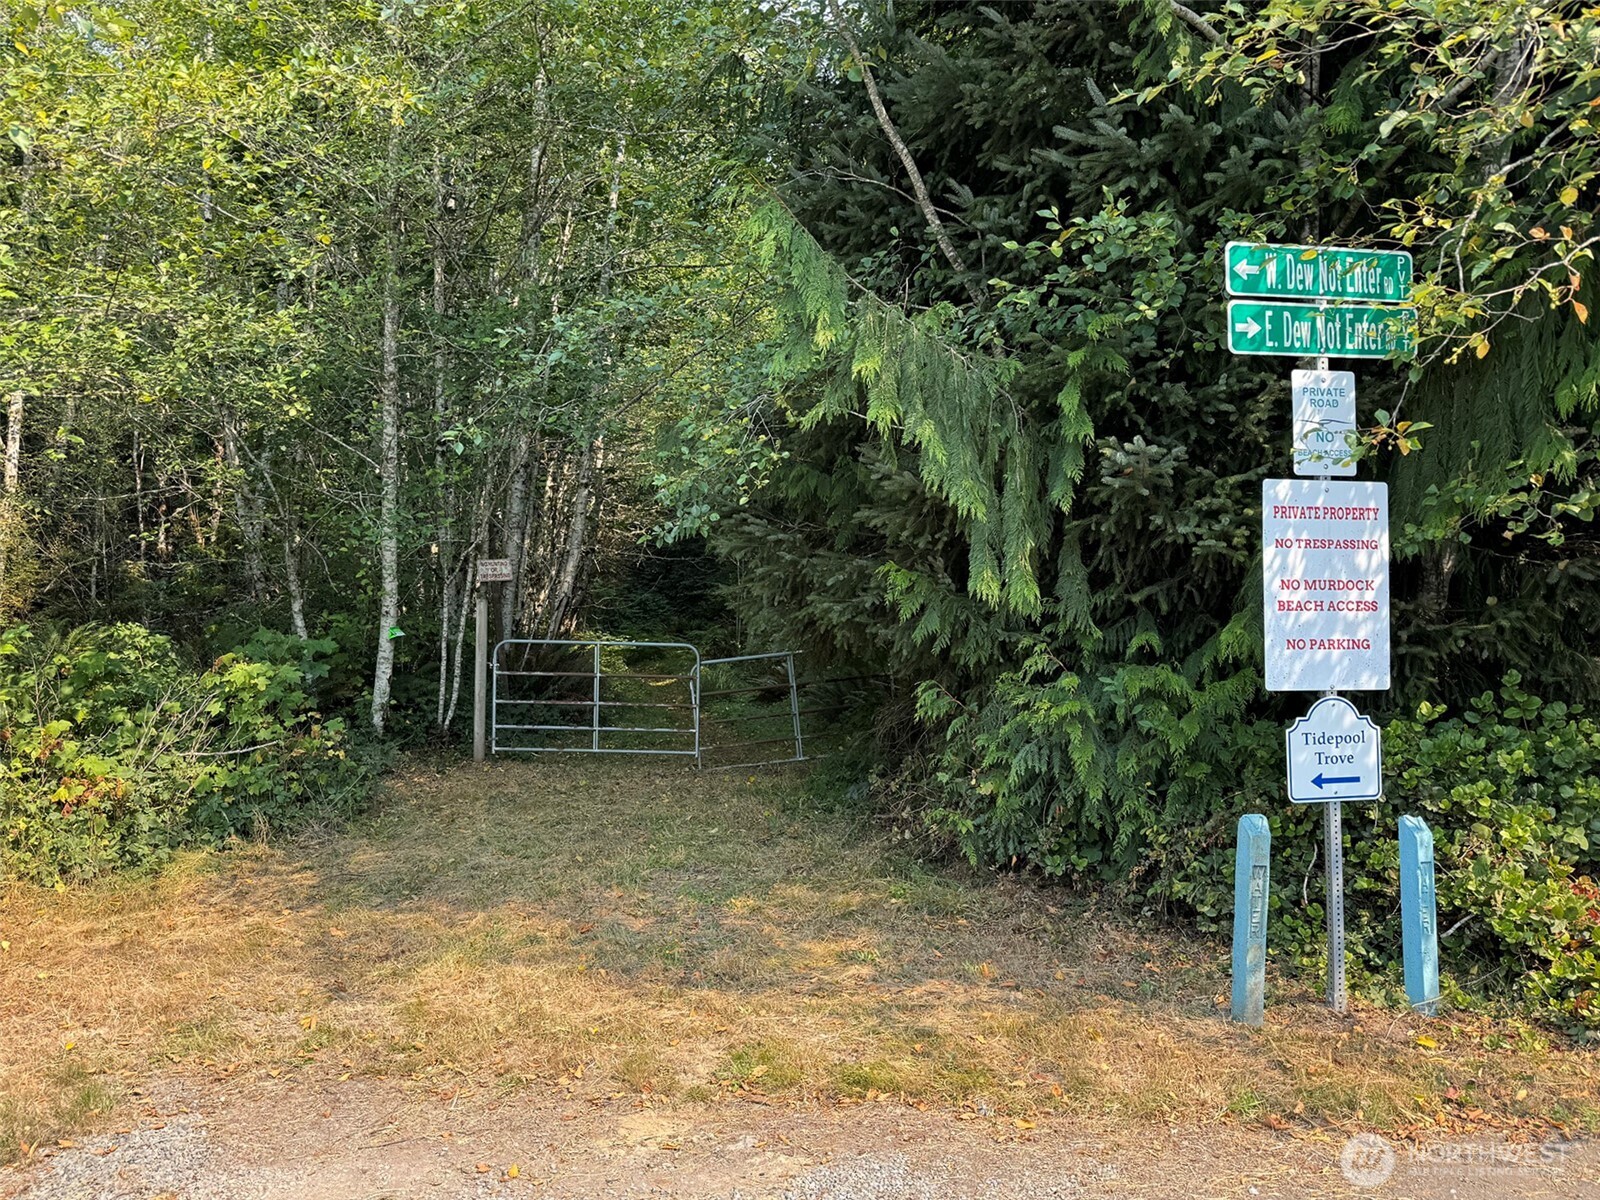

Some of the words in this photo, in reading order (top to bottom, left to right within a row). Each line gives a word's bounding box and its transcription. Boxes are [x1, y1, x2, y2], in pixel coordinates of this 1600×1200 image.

[1265, 253, 1282, 290] W.
[1286, 253, 1314, 291] Dew
[1319, 255, 1343, 293] Not
[1346, 256, 1383, 294] Enter
[1383, 277, 1394, 295] RD
[1397, 256, 1406, 299] PVT
[1265, 310, 1278, 348] E.
[1283, 311, 1311, 349] Dew
[1316, 312, 1342, 350] Not
[1346, 313, 1384, 351] Enter
[1302, 387, 1346, 398] PRIVATE
[1310, 399, 1339, 408] ROAD
[1316, 432, 1335, 443] NO
[1298, 449, 1324, 457] BEACH
[1273, 505, 1321, 520] PRIVATE
[1322, 506, 1380, 521] PROPERTY
[1275, 538, 1294, 549] NO
[1296, 538, 1379, 550] TRESPASSING
[1281, 579, 1300, 591] NO
[1304, 579, 1375, 591] MURDOCK
[1277, 600, 1324, 612] BEACH
[1327, 600, 1378, 612] ACCESS
[1286, 638, 1306, 650] NO
[1309, 638, 1371, 650] PARKING
[1302, 730, 1366, 749] Tidepool
[1315, 752, 1355, 765] Trove
[1251, 865, 1266, 939] WATER
